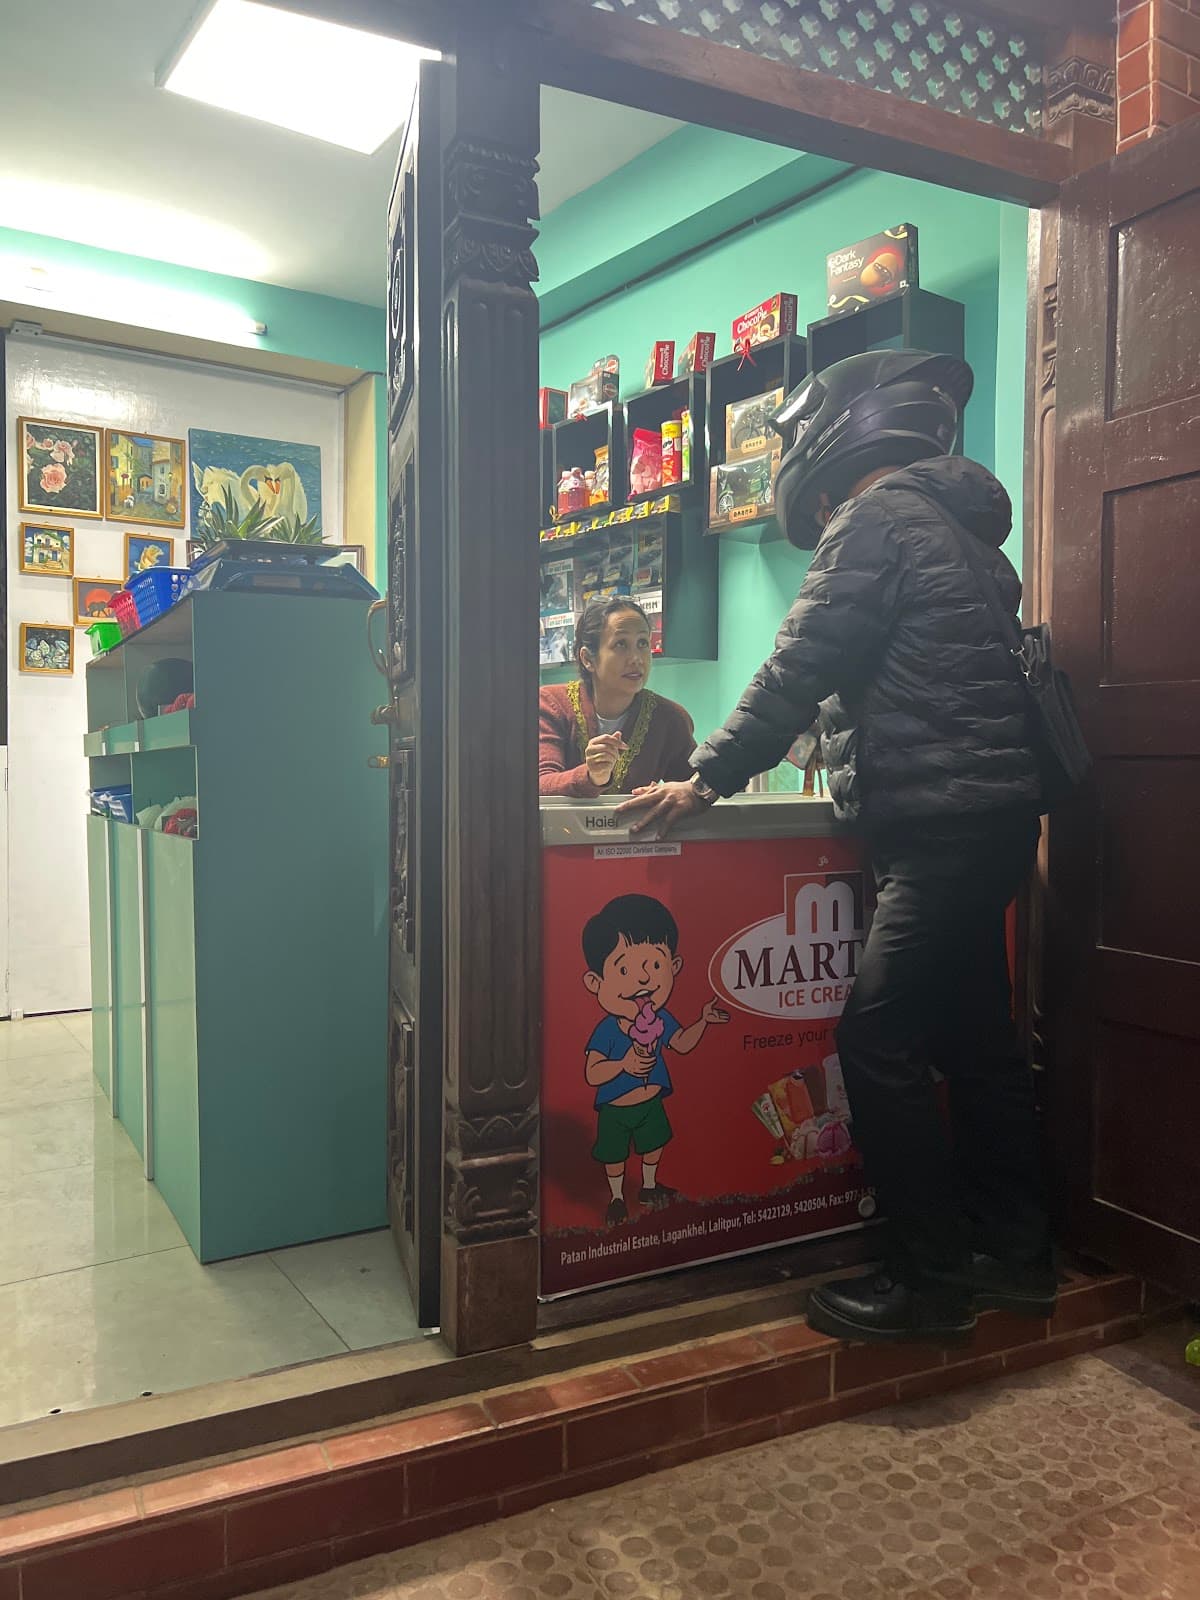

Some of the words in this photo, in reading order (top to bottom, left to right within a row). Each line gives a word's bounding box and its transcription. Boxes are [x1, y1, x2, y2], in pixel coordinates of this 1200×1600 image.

[830, 257, 865, 276] Fantasy
[779, 989, 805, 1008] ICE
[743, 1032, 793, 1050] Freeze
[798, 1028, 828, 1047] your
[560, 1251, 587, 1265] Patan
[588, 1237, 631, 1259] Industrial
[632, 1236, 661, 1250] Estate,
[662, 1221, 707, 1245] Lagankhel,
[708, 1216, 742, 1233] Lalitpur,
[742, 1210, 757, 1225] Tel:
[757, 1203, 793, 1222] 5422129,
[794, 1196, 828, 1214] 5420504,
[829, 1193, 844, 1208] Fax:
